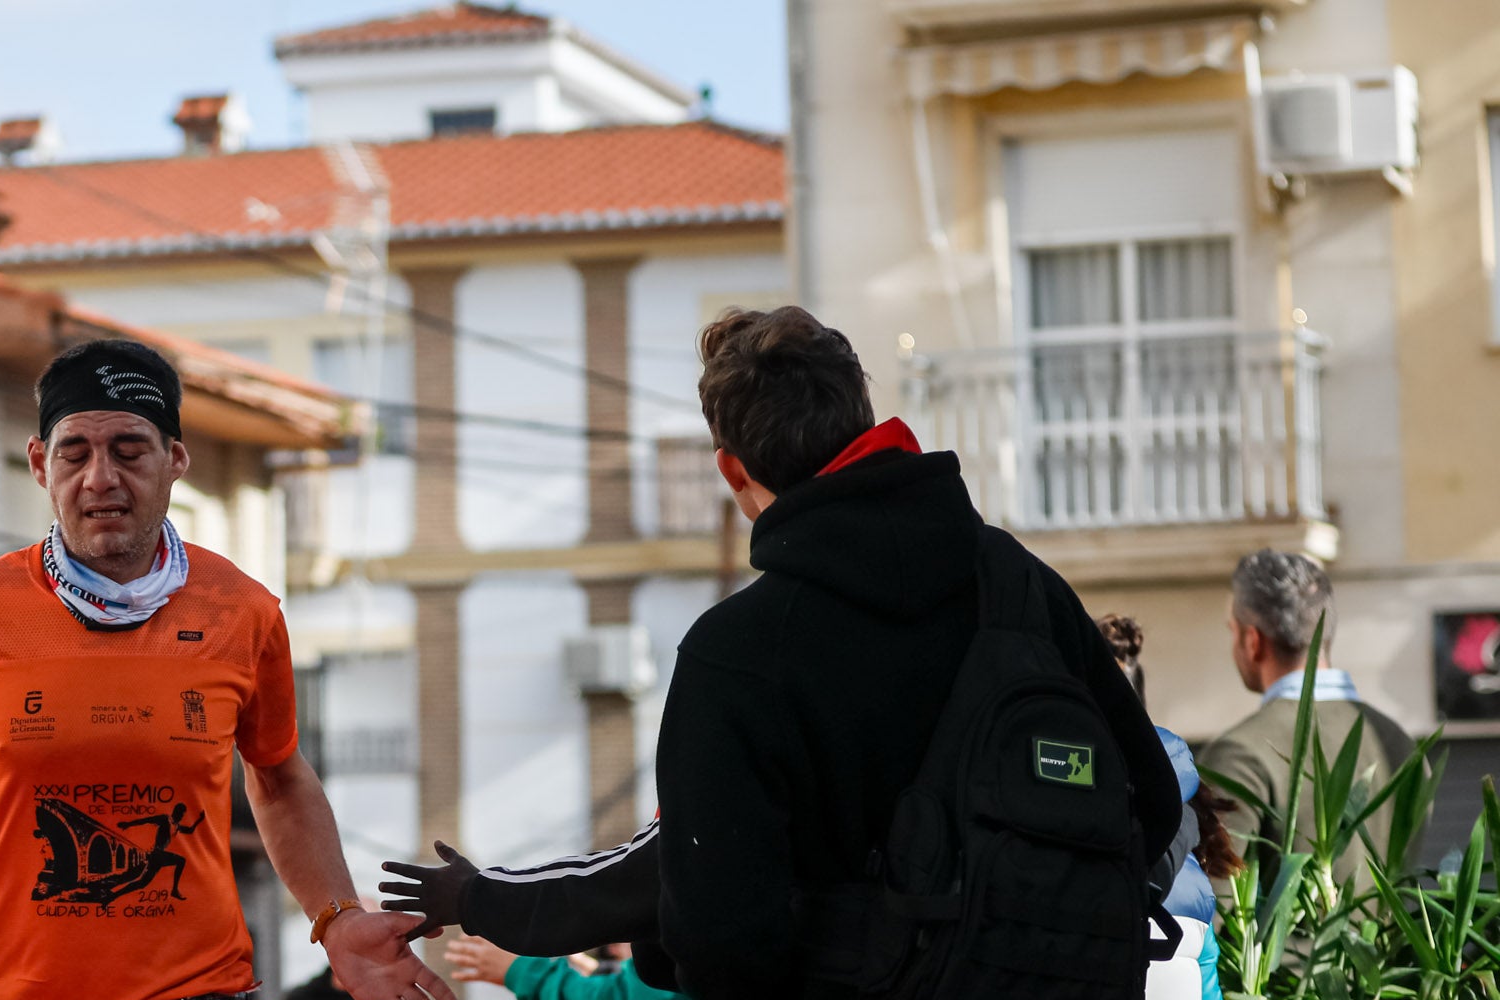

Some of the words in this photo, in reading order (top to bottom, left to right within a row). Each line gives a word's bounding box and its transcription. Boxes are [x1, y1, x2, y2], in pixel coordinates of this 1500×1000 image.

[91, 714, 135, 724] ORGIVA
[33, 784, 69, 796] XXXI
[73, 783, 175, 803] PREMIO
[88, 805, 105, 815] DE
[111, 805, 156, 815] FONDO
[138, 889, 168, 902] 2019
[36, 904, 89, 917] CIUDAD
[95, 906, 116, 917] DE
